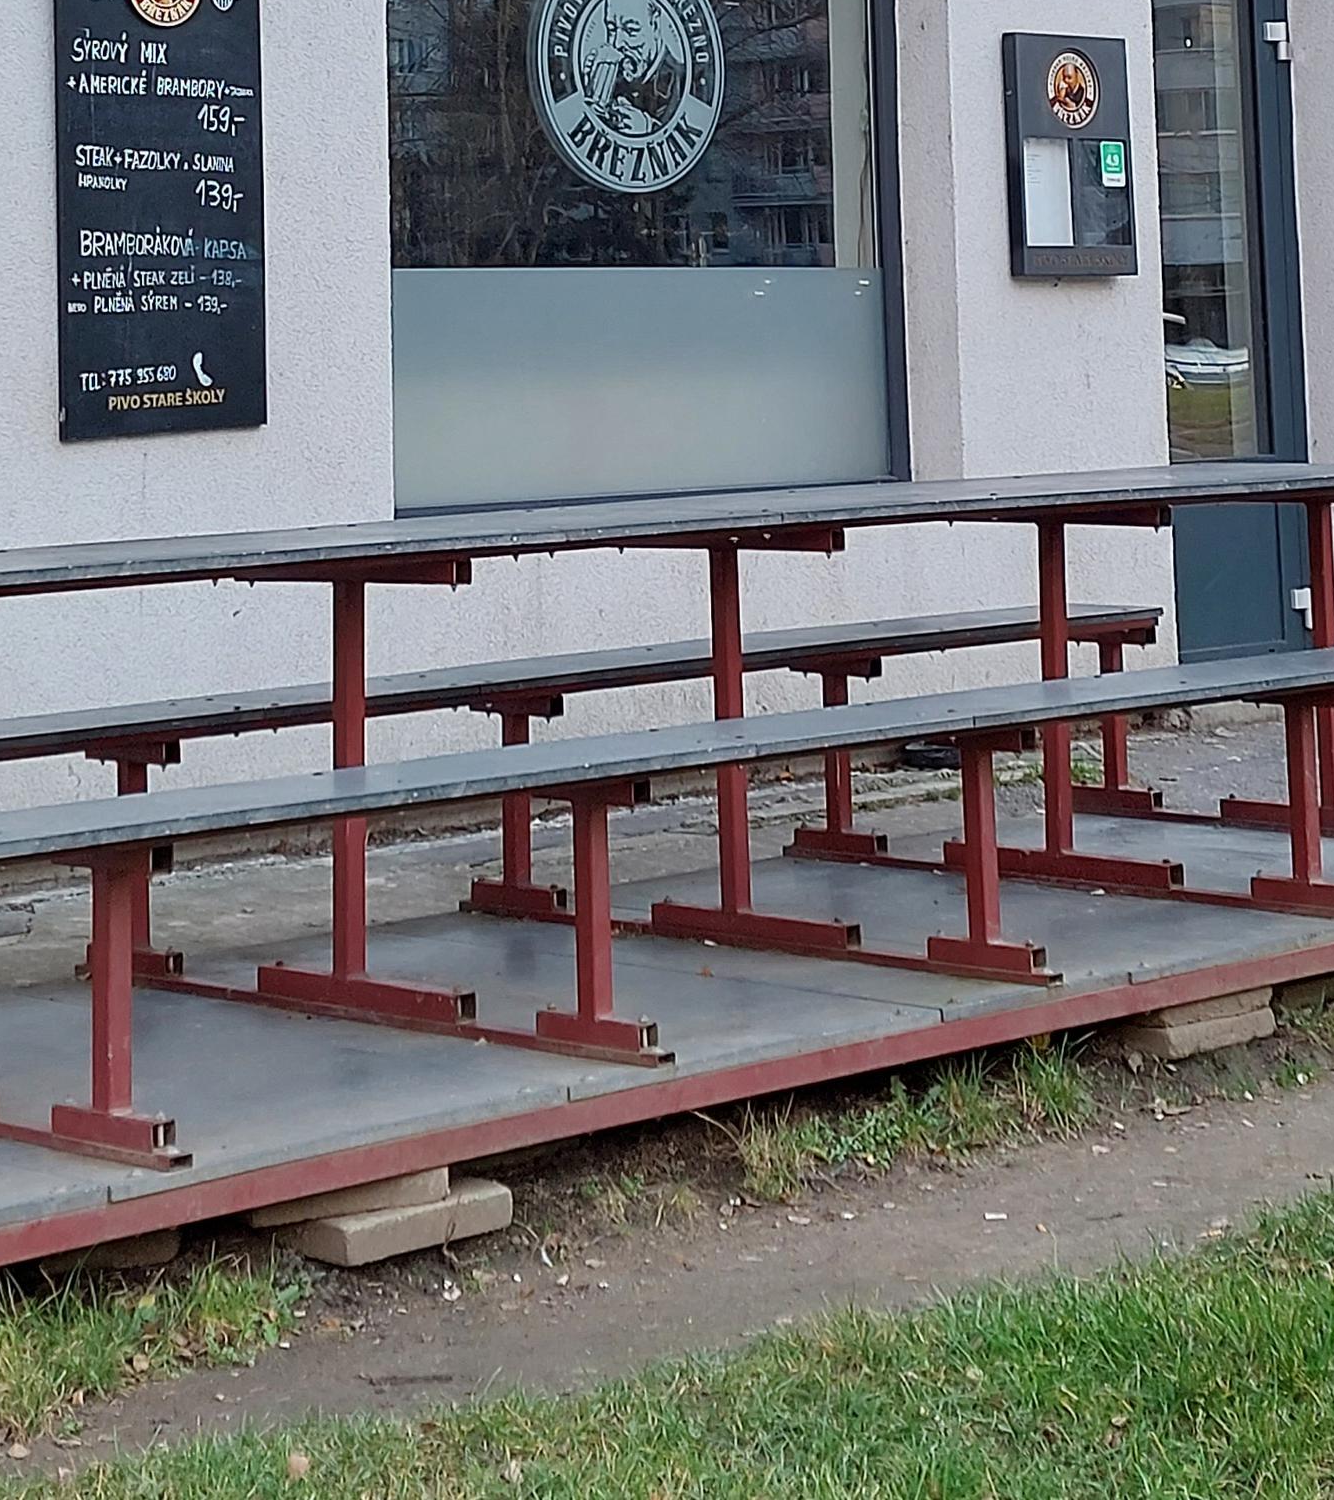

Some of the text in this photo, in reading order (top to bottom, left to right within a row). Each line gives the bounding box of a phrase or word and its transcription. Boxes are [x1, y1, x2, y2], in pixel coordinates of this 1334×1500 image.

[140, 41, 167, 65] MIX
[567, 112, 704, 184] BŘEZŇÁK
[204, 237, 247, 260] KAPSA
[133, 270, 166, 287] STEAK
[107, 369, 133, 387] 775
[108, 395, 141, 411] PIVO
[185, 388, 226, 405] ŠKOLY
